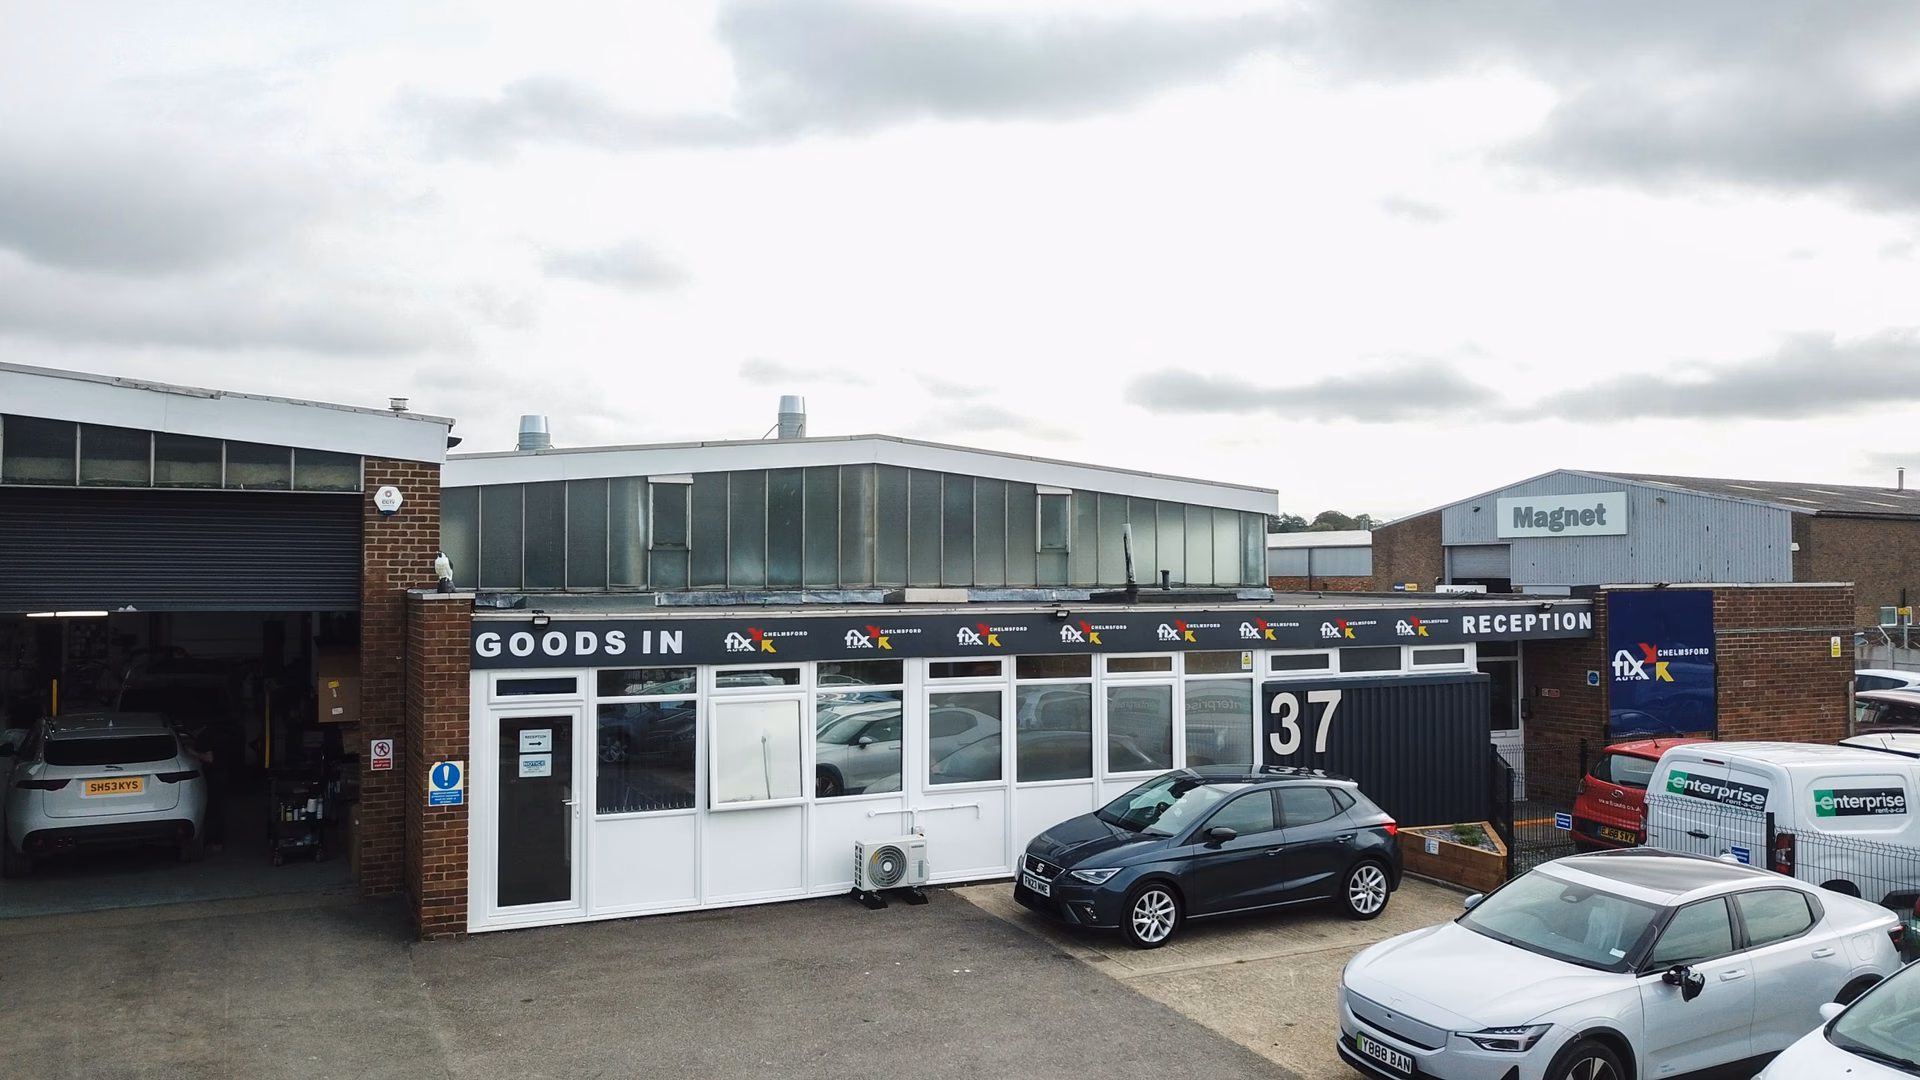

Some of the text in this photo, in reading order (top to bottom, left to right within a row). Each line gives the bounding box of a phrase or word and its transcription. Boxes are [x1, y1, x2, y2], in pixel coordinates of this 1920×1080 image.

[1513, 503, 1607, 532] Magnet
[1156, 623, 1181, 640] fix
[1239, 622, 1261, 638] fix
[1320, 622, 1342, 638] fix
[1396, 620, 1415, 635] fix
[1462, 612, 1592, 634] RECEPTION
[724, 632, 756, 650] fix
[844, 629, 873, 648] fix
[956, 626, 983, 645] fix
[1060, 624, 1085, 642] fix
[475, 630, 683, 657] GOODS IN
[1657, 648, 1709, 657] CHELMSFORD
[1612, 650, 1650, 680] fix
[1270, 690, 1342, 756] 37
[90, 780, 138, 792] SH53 KYS
[1669, 776, 1765, 804] enterprise
[1726, 798, 1763, 810] rent-a-car
[1816, 792, 1904, 812] enterprise
[1363, 1038, 1410, 1072] Y888 BAN
